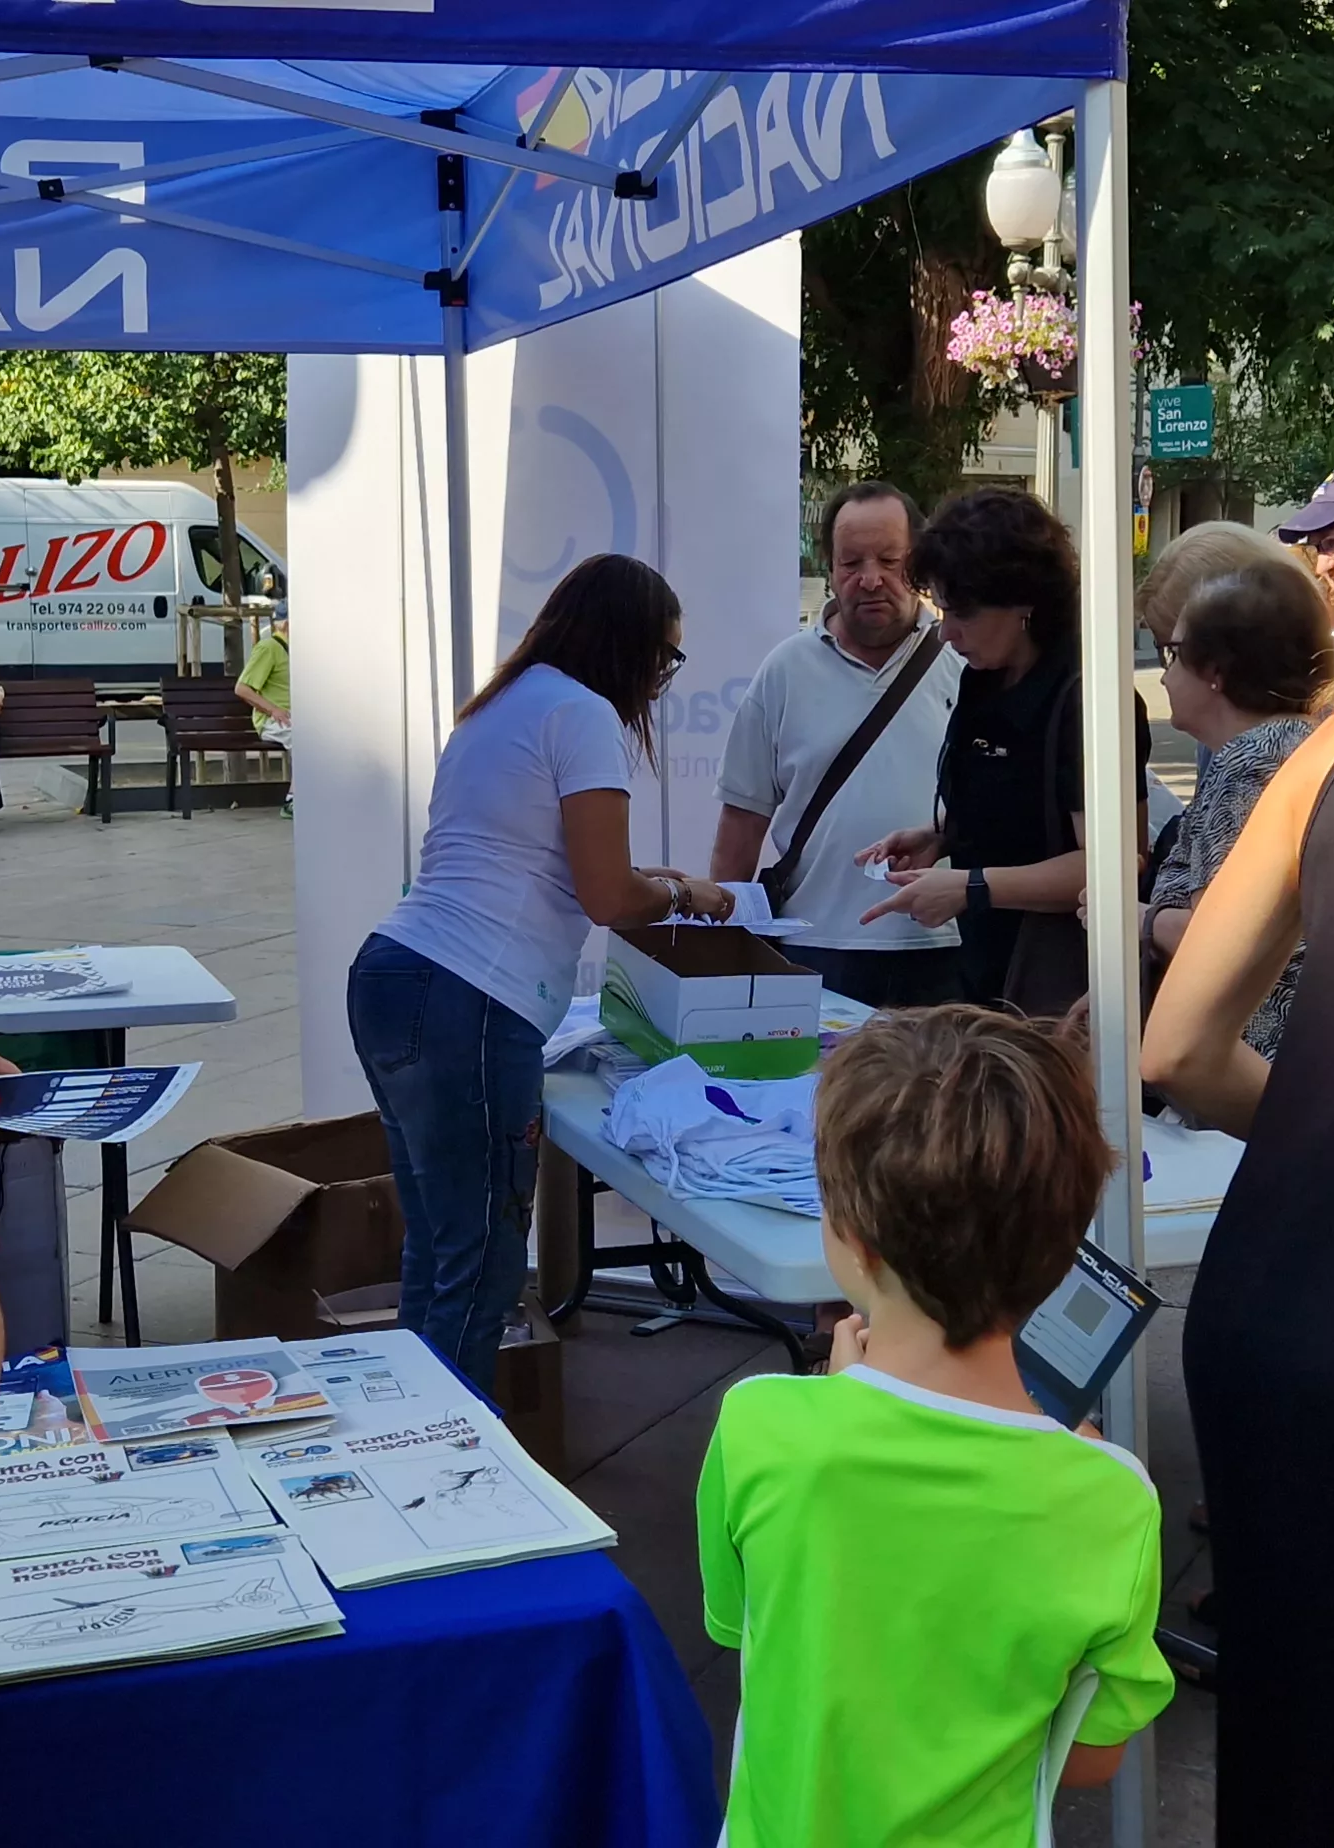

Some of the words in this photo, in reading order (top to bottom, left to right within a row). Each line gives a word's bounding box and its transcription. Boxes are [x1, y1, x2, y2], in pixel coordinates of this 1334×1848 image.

[1157, 394, 1181, 407] vive
[1157, 407, 1182, 420] San
[1158, 420, 1208, 434] Lorenzo
[31, 602, 55, 615] Tel.
[58, 602, 83, 615] 974
[86, 602, 104, 615] 22
[107, 602, 125, 615] 09
[128, 602, 146, 615] 44
[6, 620, 147, 632] transportescallizo.com
[38, 1511, 132, 1528] POLICIA
